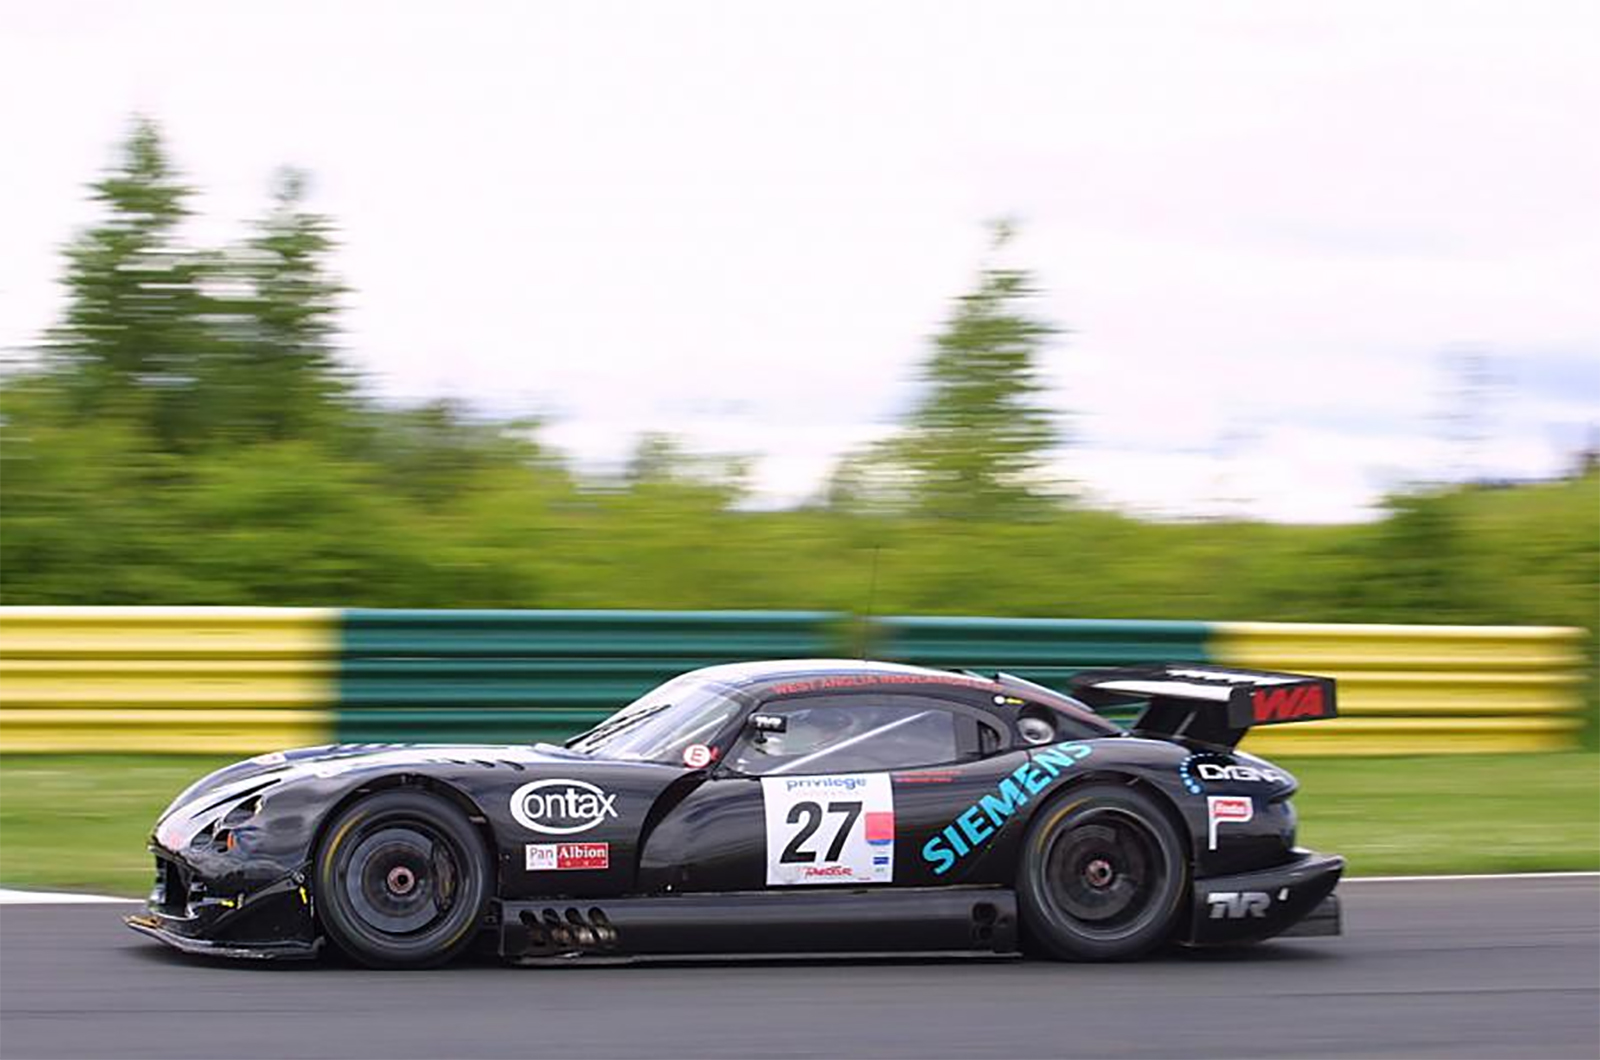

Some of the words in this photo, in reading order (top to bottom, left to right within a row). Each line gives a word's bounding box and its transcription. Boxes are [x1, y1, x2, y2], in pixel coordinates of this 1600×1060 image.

[1253, 685, 1323, 720] WA
[786, 778, 867, 792] privilege
[922, 741, 1092, 875] SIEMENS
[780, 801, 863, 864] 27
[529, 847, 554, 860] Pan
[558, 846, 606, 859] Albion
[1207, 892, 1271, 918] TVR
